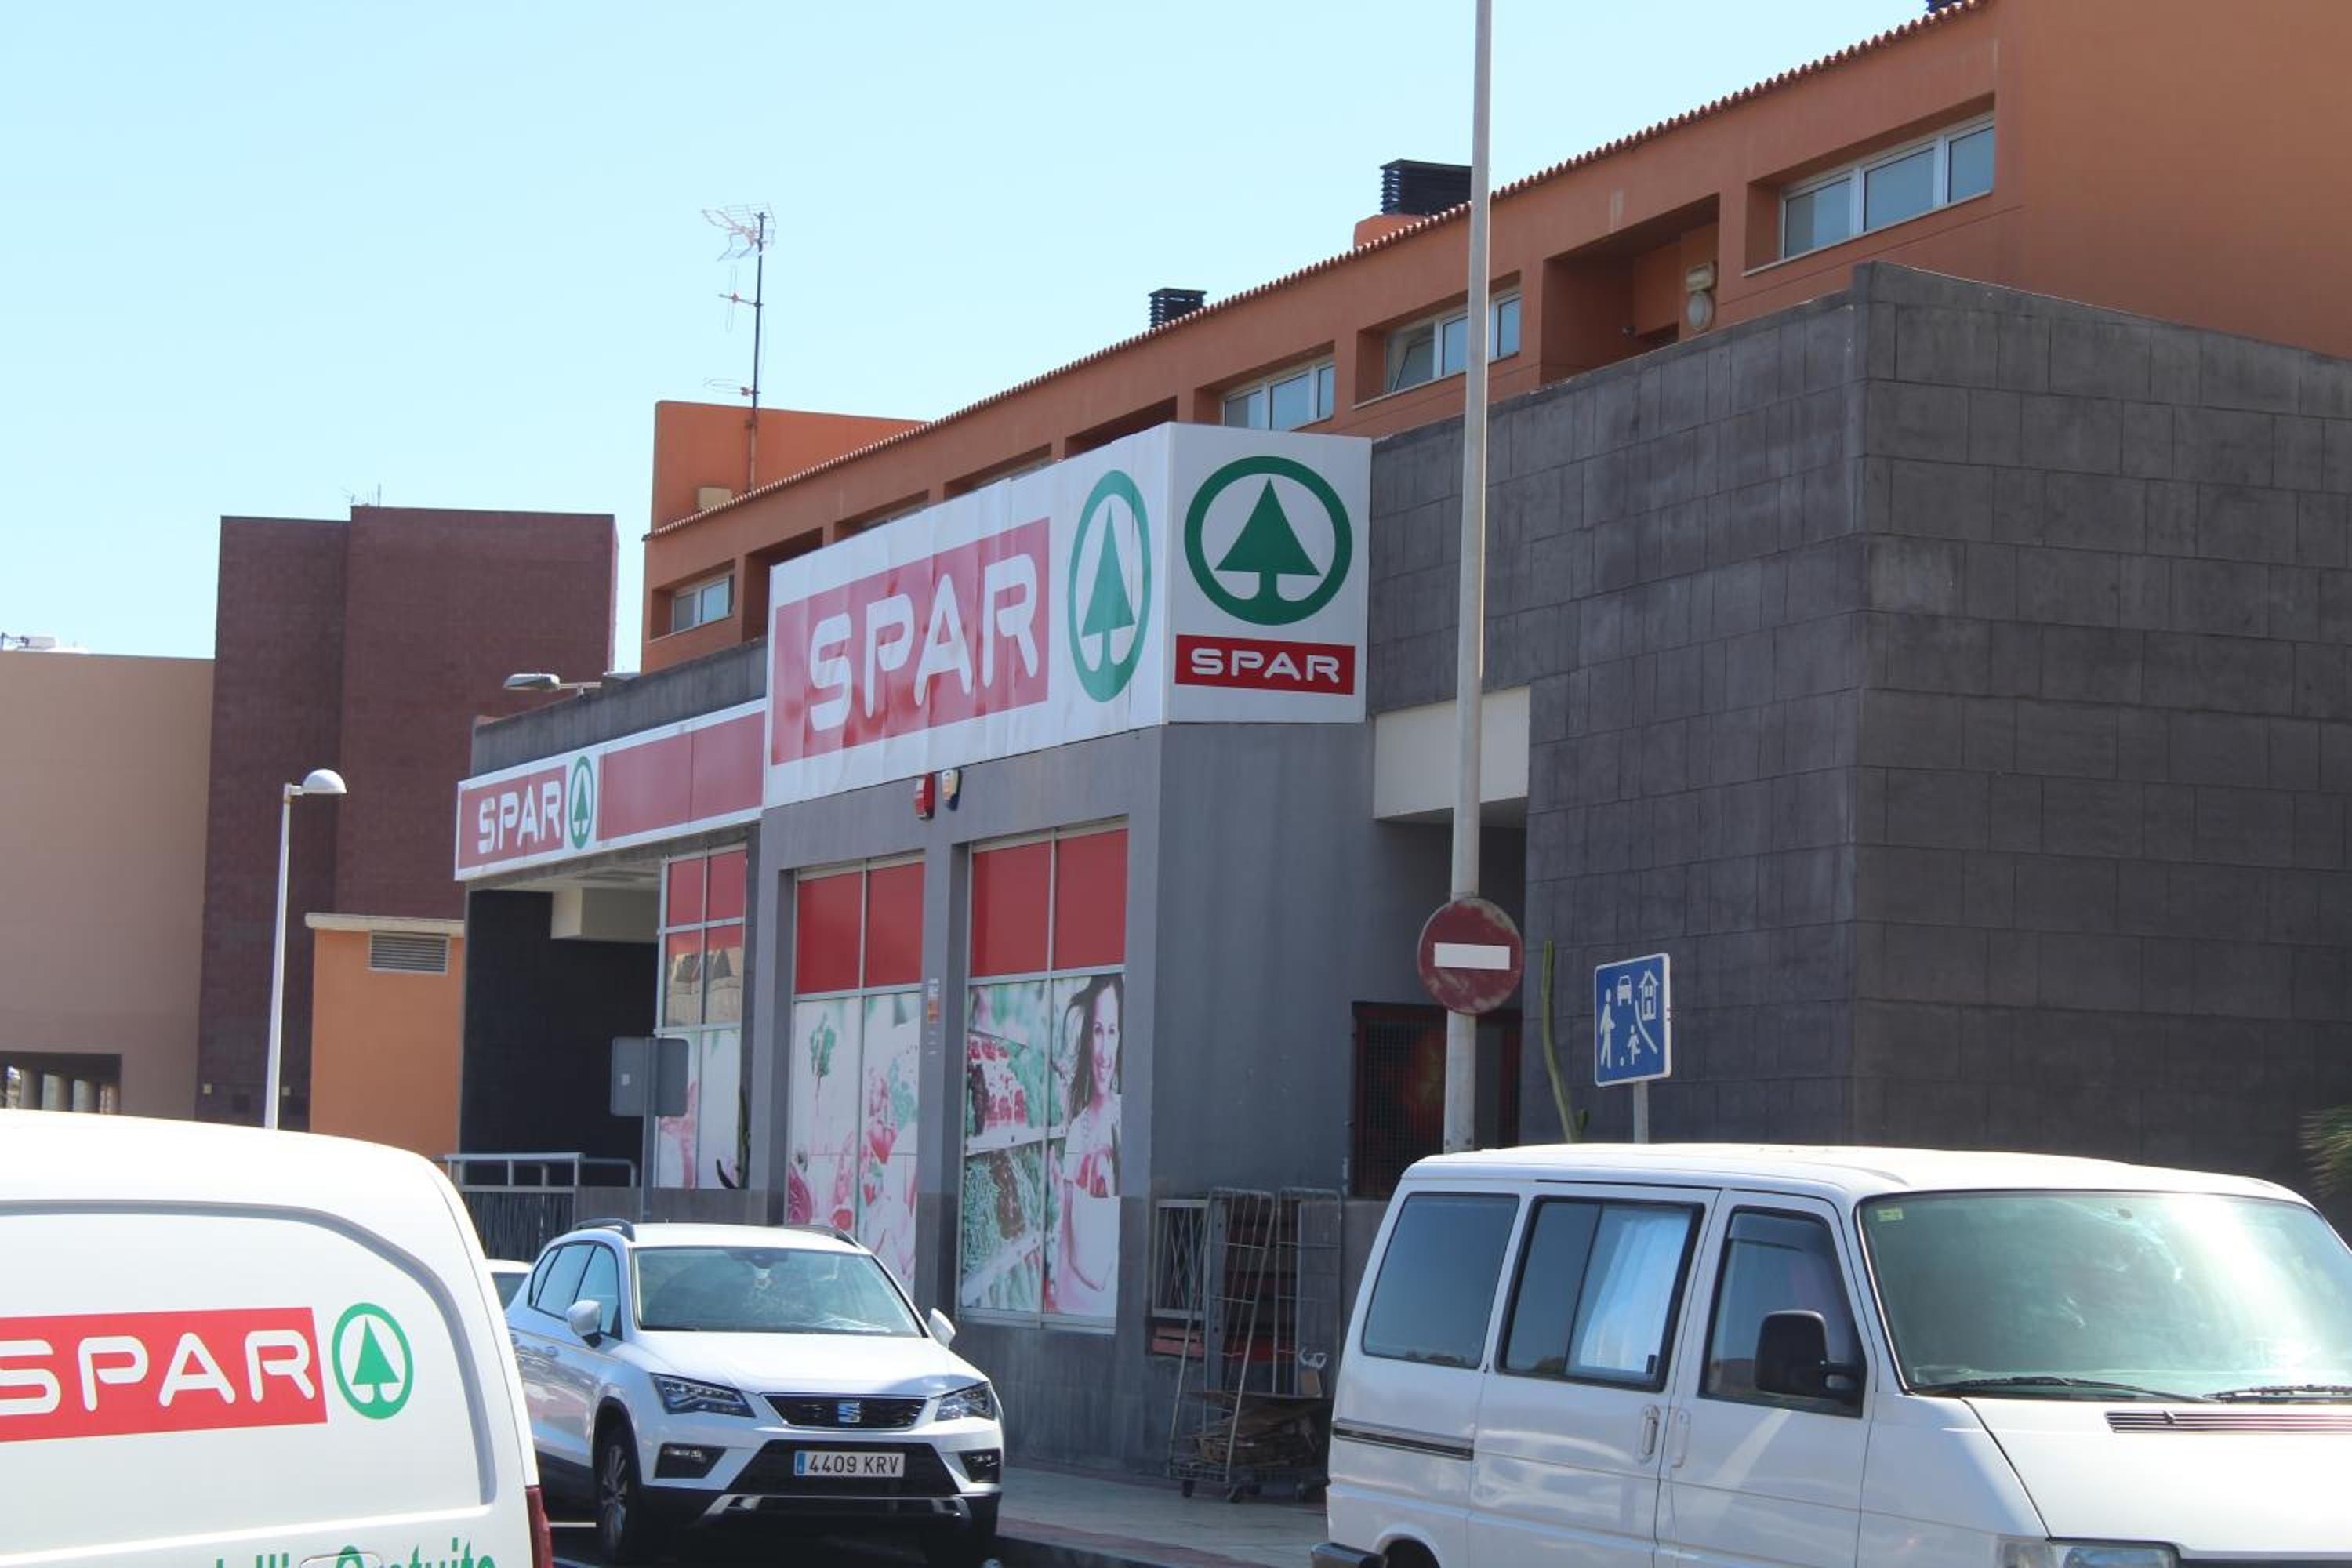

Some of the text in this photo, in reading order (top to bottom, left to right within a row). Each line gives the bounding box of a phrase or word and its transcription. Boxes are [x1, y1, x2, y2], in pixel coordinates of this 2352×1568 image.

[810, 553, 1038, 731] SPAR
[1191, 648, 1340, 684] SPAR
[477, 780, 561, 854] SPAR
[0, 1330, 315, 1416] SPAR
[809, 1454, 899, 1474] 4409 KRV
